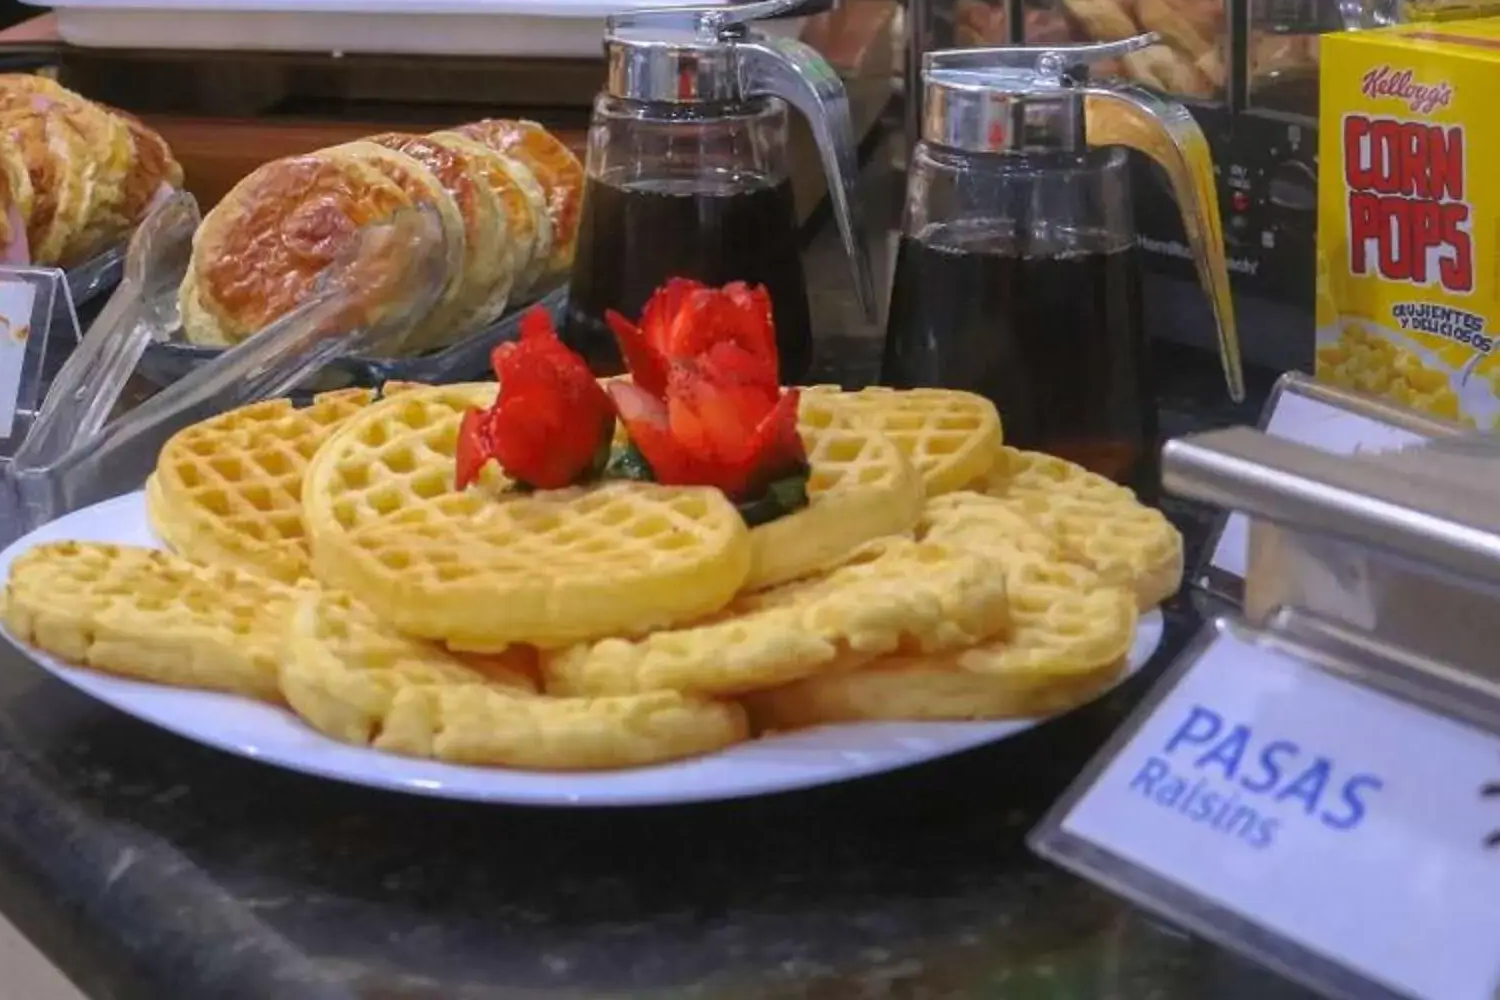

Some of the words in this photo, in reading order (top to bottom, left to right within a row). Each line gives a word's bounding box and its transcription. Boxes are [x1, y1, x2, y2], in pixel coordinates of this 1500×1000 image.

[1362, 65, 1452, 114] Kellogg's
[1344, 115, 1464, 200] CORN
[1349, 192, 1474, 292] POPS
[1129, 756, 1282, 848] Raisins
[1163, 704, 1384, 831] PASAS
